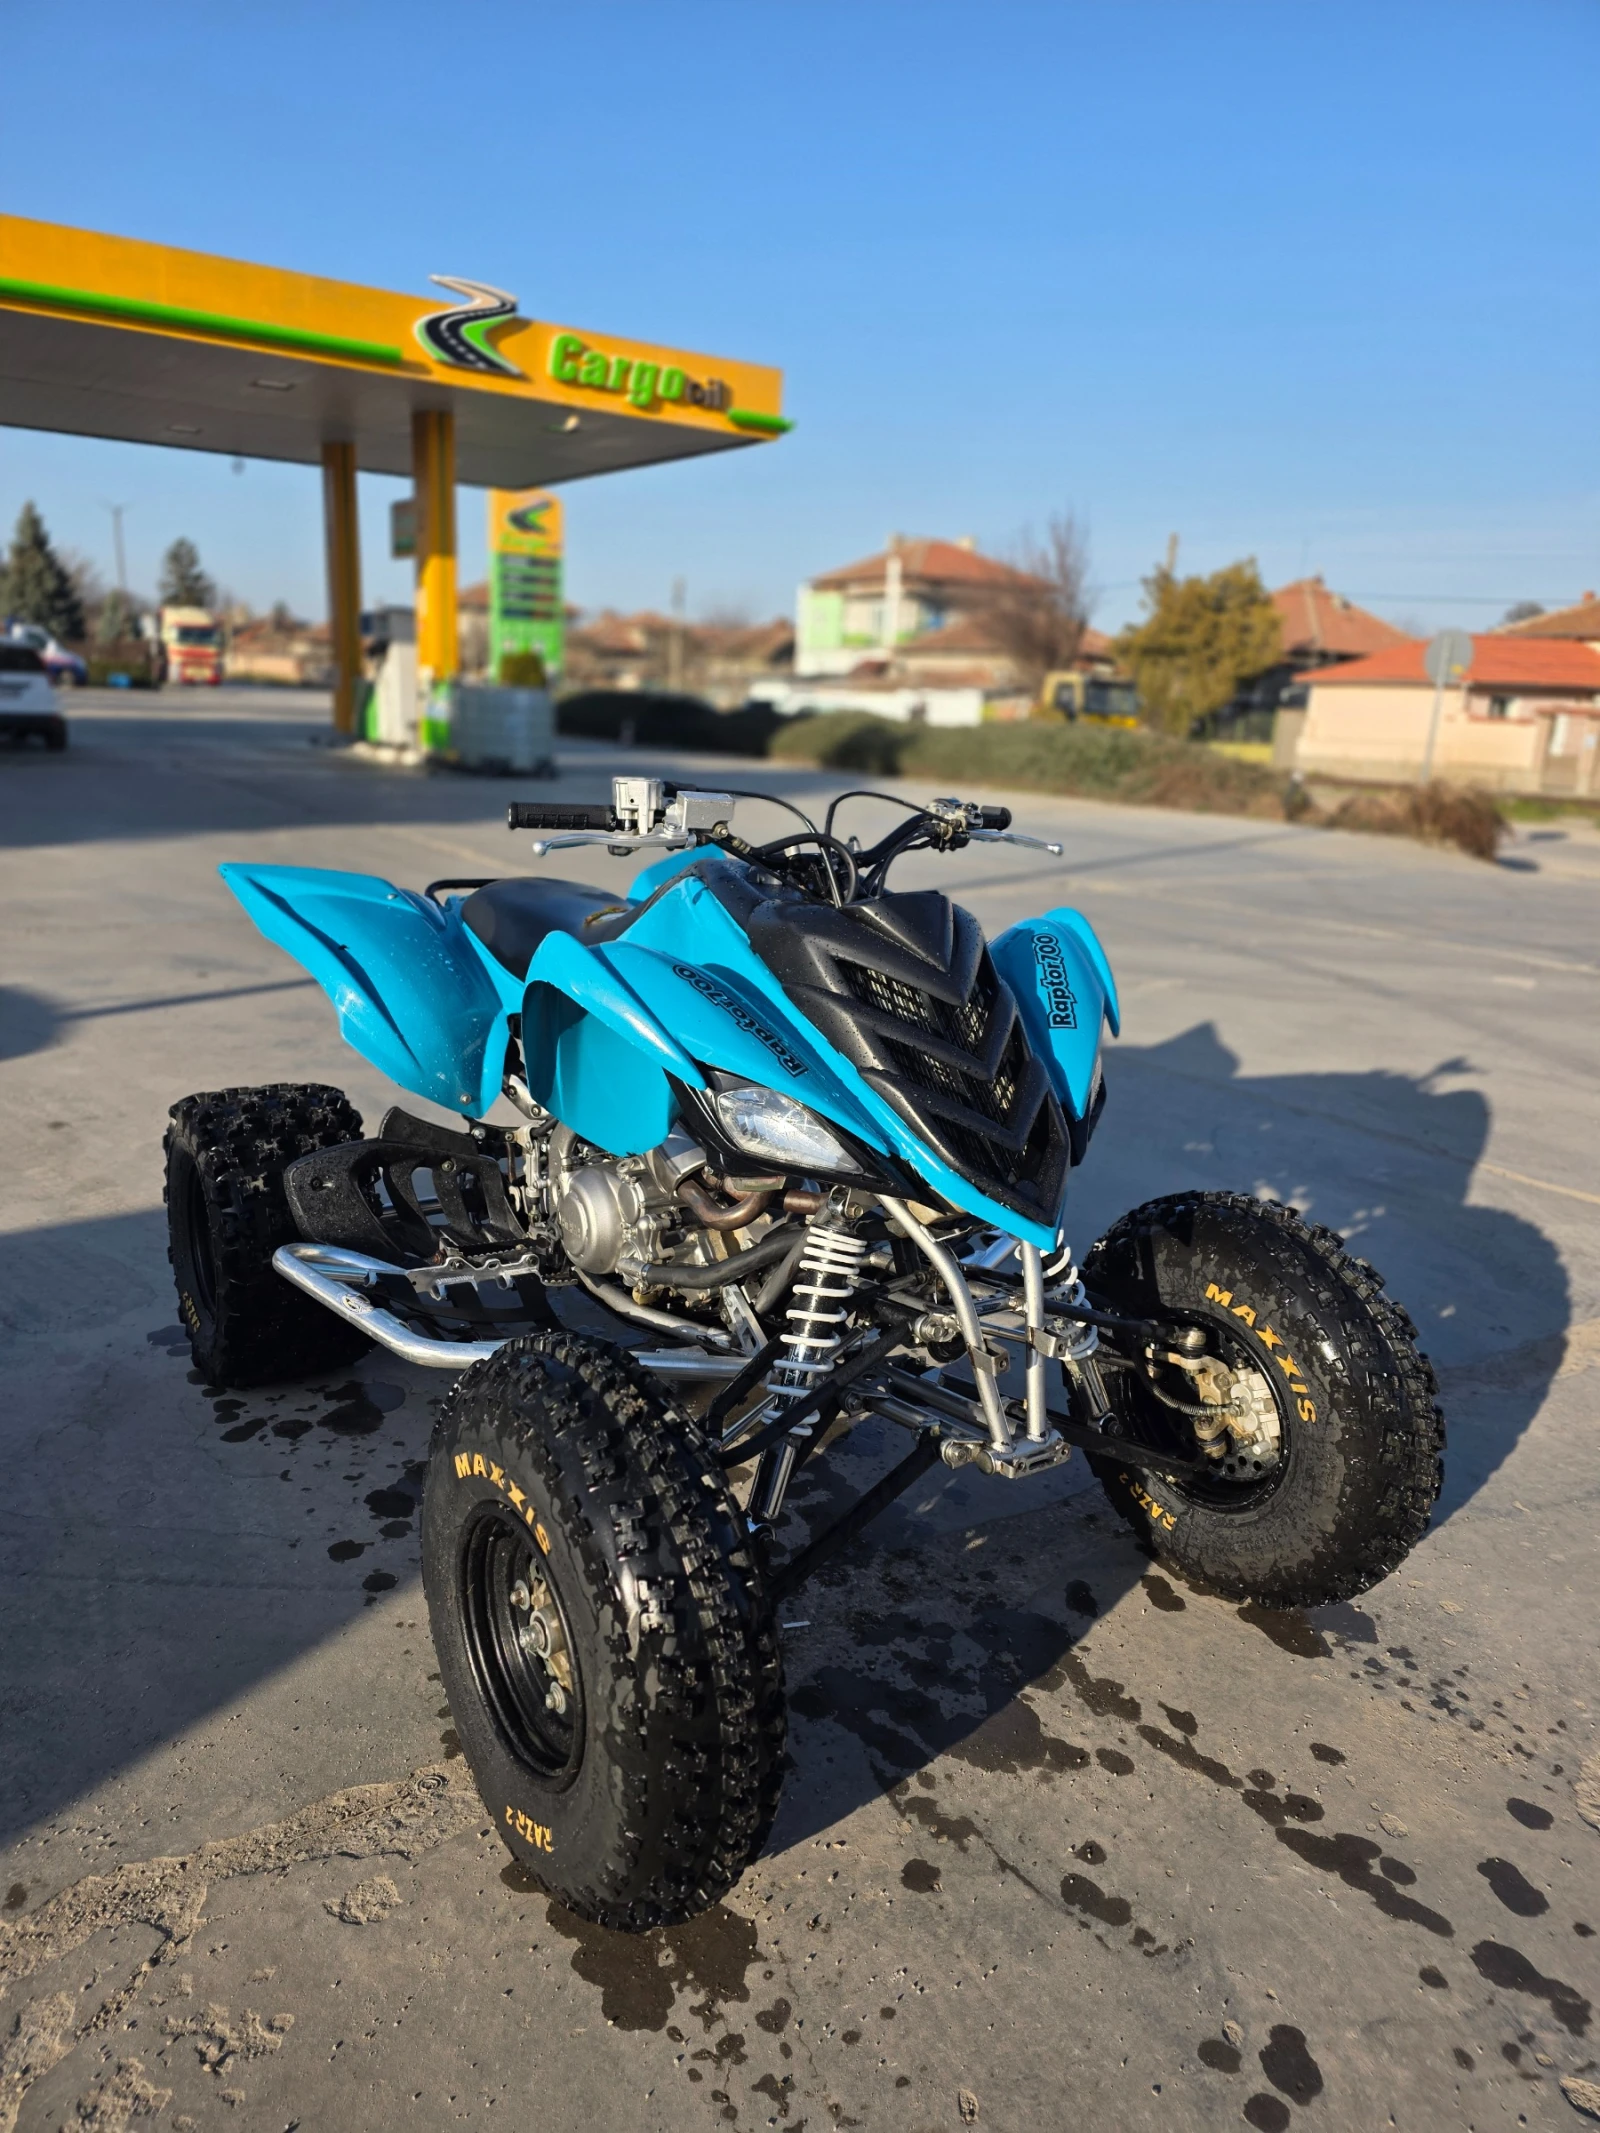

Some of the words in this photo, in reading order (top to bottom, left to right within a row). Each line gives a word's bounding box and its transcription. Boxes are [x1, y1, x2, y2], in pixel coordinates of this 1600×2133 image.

[548, 333, 684, 405] Cargo
[1205, 1282, 1316, 1423] MAXXIS
[454, 1452, 551, 1555] MAXXIS
[1129, 1481, 1177, 1531] RAZR
[516, 1809, 553, 1853] RAZR
